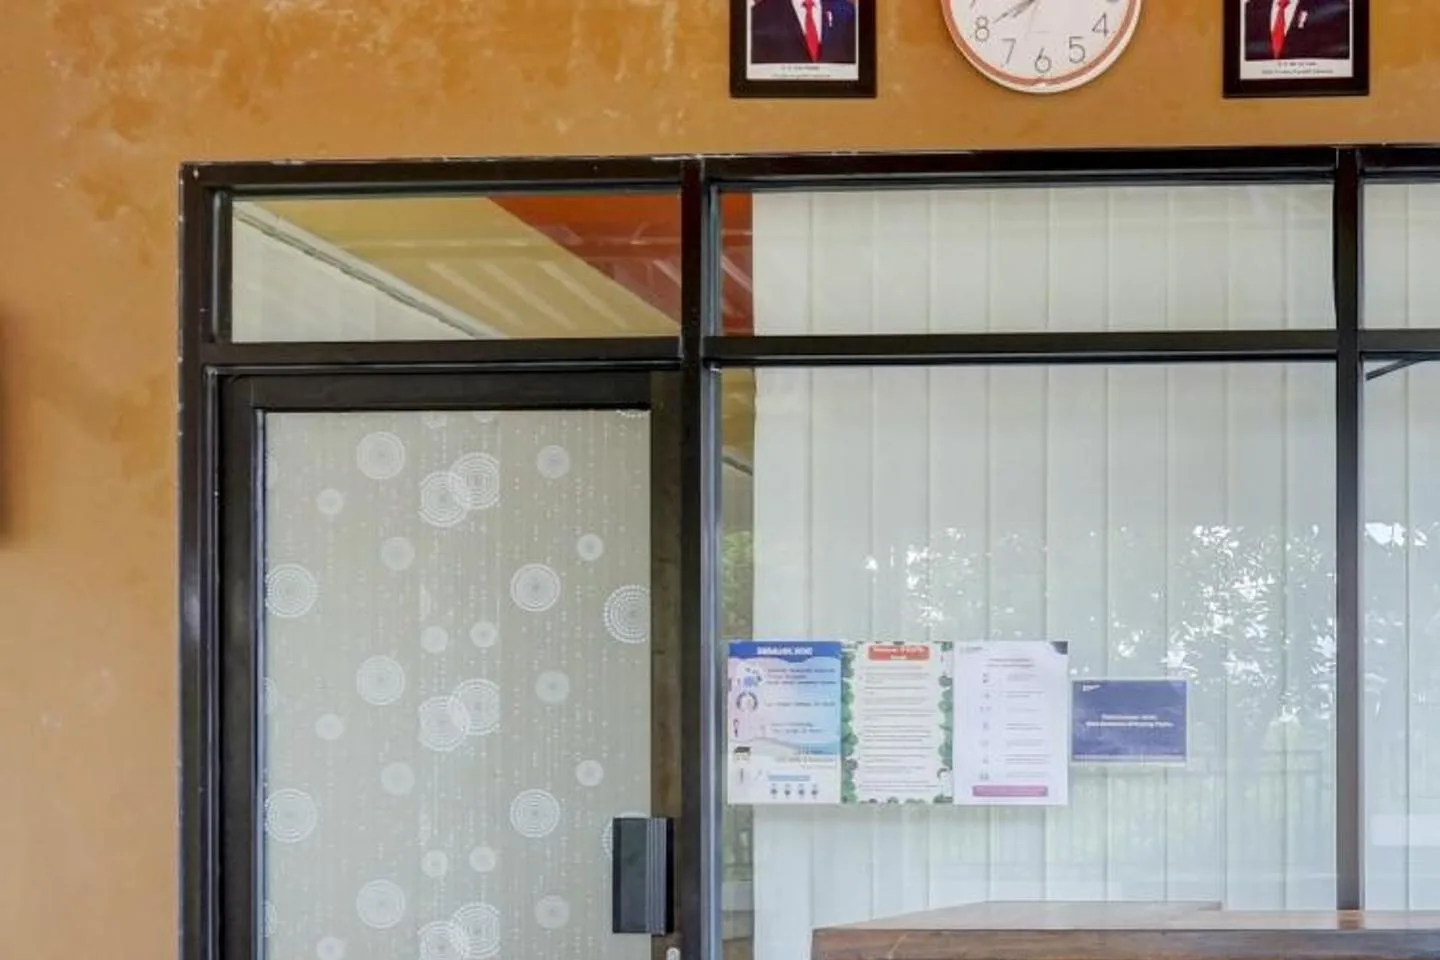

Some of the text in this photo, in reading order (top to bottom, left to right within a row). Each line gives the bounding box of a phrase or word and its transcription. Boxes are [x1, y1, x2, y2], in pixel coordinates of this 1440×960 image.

[975, 16, 990, 42] 8
[1091, 12, 1110, 37] 4
[1000, 38, 1017, 65] 7
[1034, 47, 1052, 74] 6
[1068, 36, 1086, 64] 5
